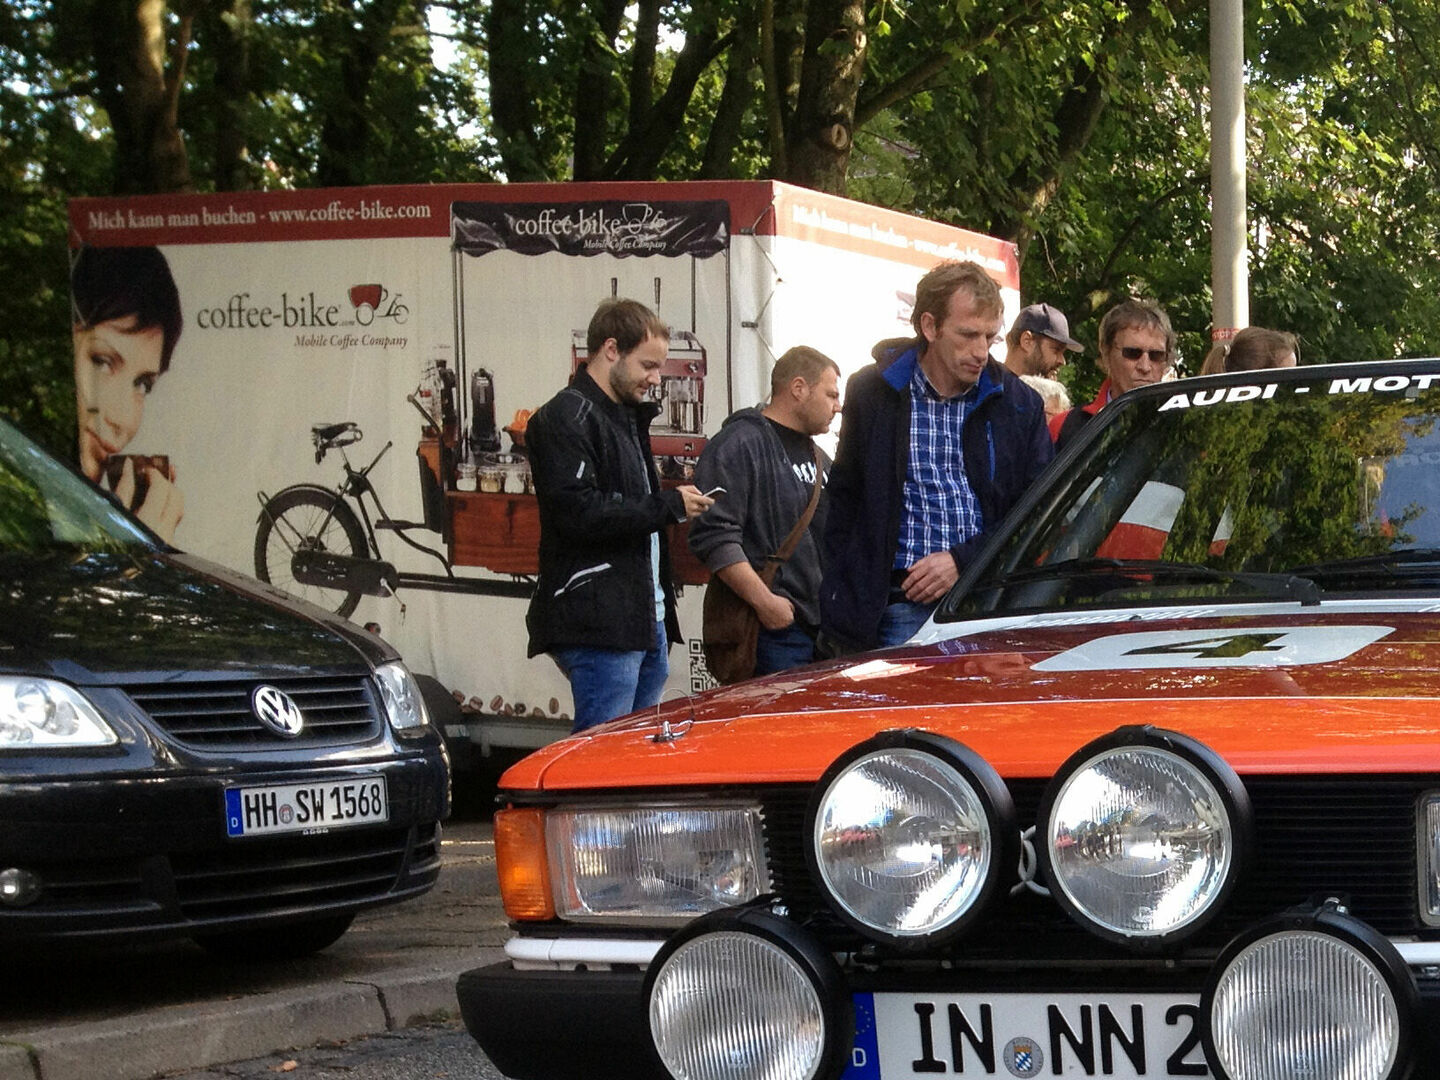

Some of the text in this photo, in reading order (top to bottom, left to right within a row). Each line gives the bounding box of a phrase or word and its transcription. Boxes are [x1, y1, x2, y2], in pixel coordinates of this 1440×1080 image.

[88, 211, 125, 230] Mich
[128, 209, 164, 228] kann
[168, 213, 199, 227] man
[202, 206, 256, 226] buchen
[269, 200, 432, 222] www.coffee-bike.com
[294, 333, 408, 350] Mobile Coffee Company
[1157, 383, 1277, 413] AUDI
[1121, 632, 1289, 659] 4
[244, 783, 382, 828] HH SW 1568
[231, 817, 239, 828] D
[912, 1002, 996, 1074] IN
[1047, 1003, 1147, 1076] NN
[852, 1047, 867, 1067] D
